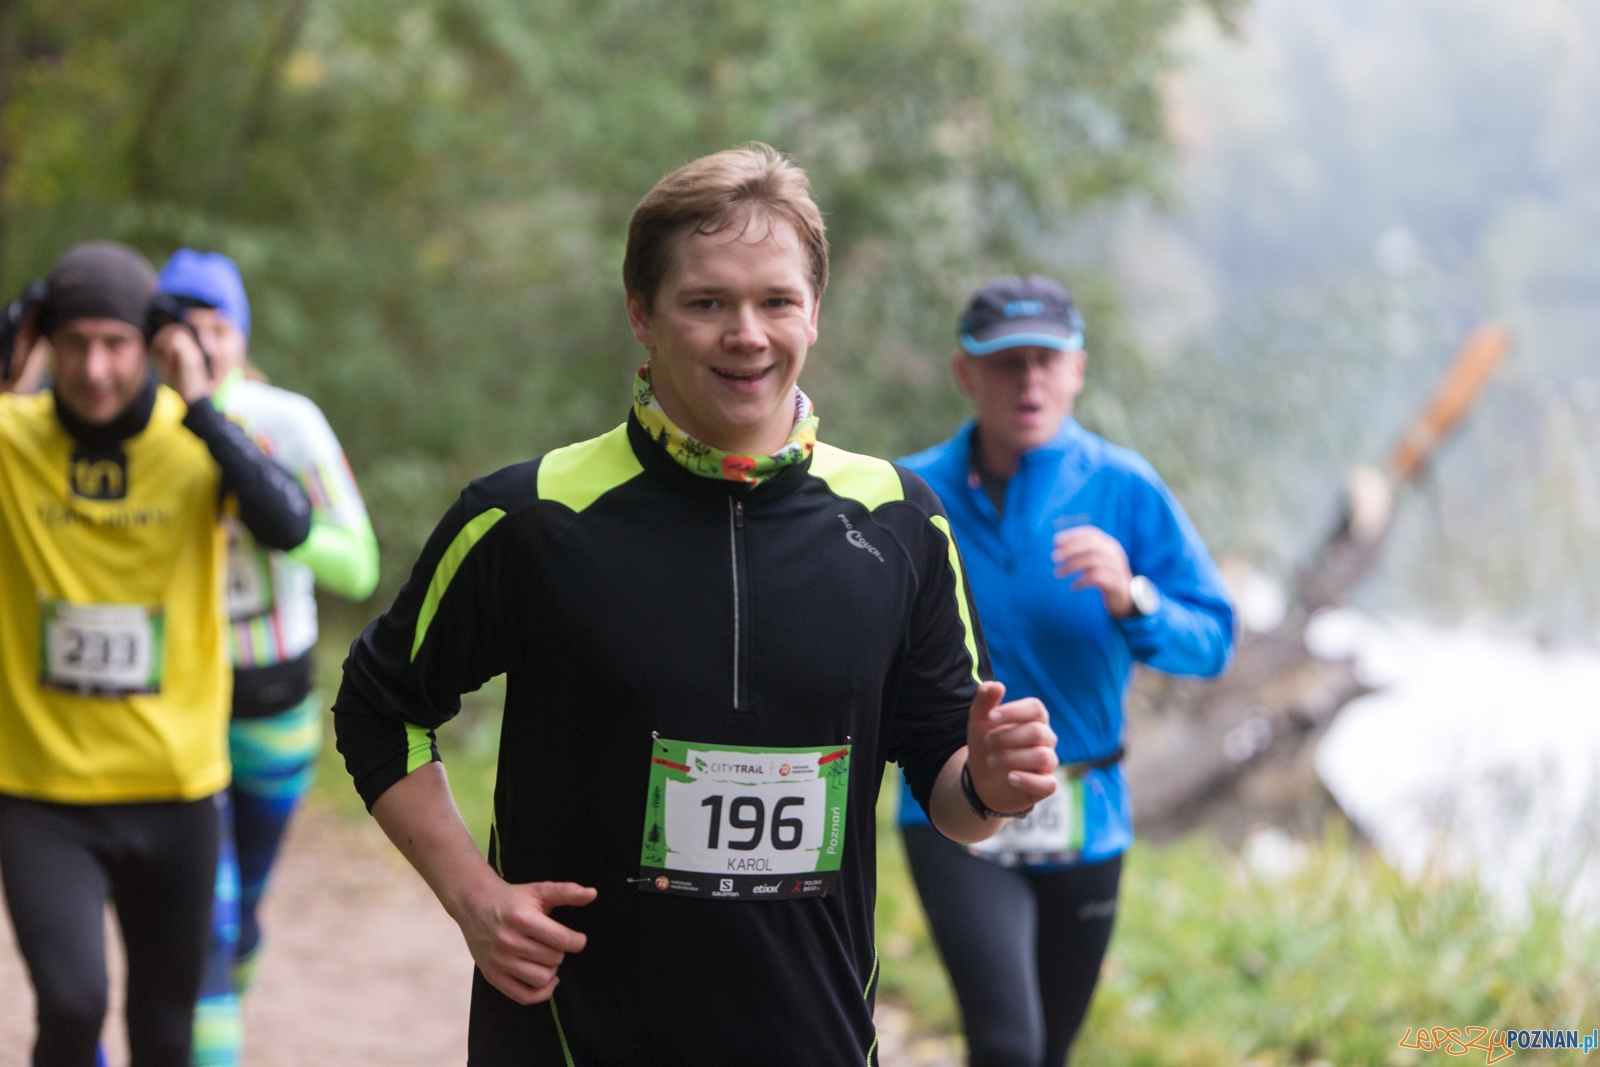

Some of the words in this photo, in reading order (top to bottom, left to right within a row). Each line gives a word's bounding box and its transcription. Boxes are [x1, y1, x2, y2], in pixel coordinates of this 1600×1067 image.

[837, 513, 853, 530] PRO
[701, 795, 805, 851] 196
[826, 806, 840, 855] Poznań
[727, 858, 773, 871] KAROL
